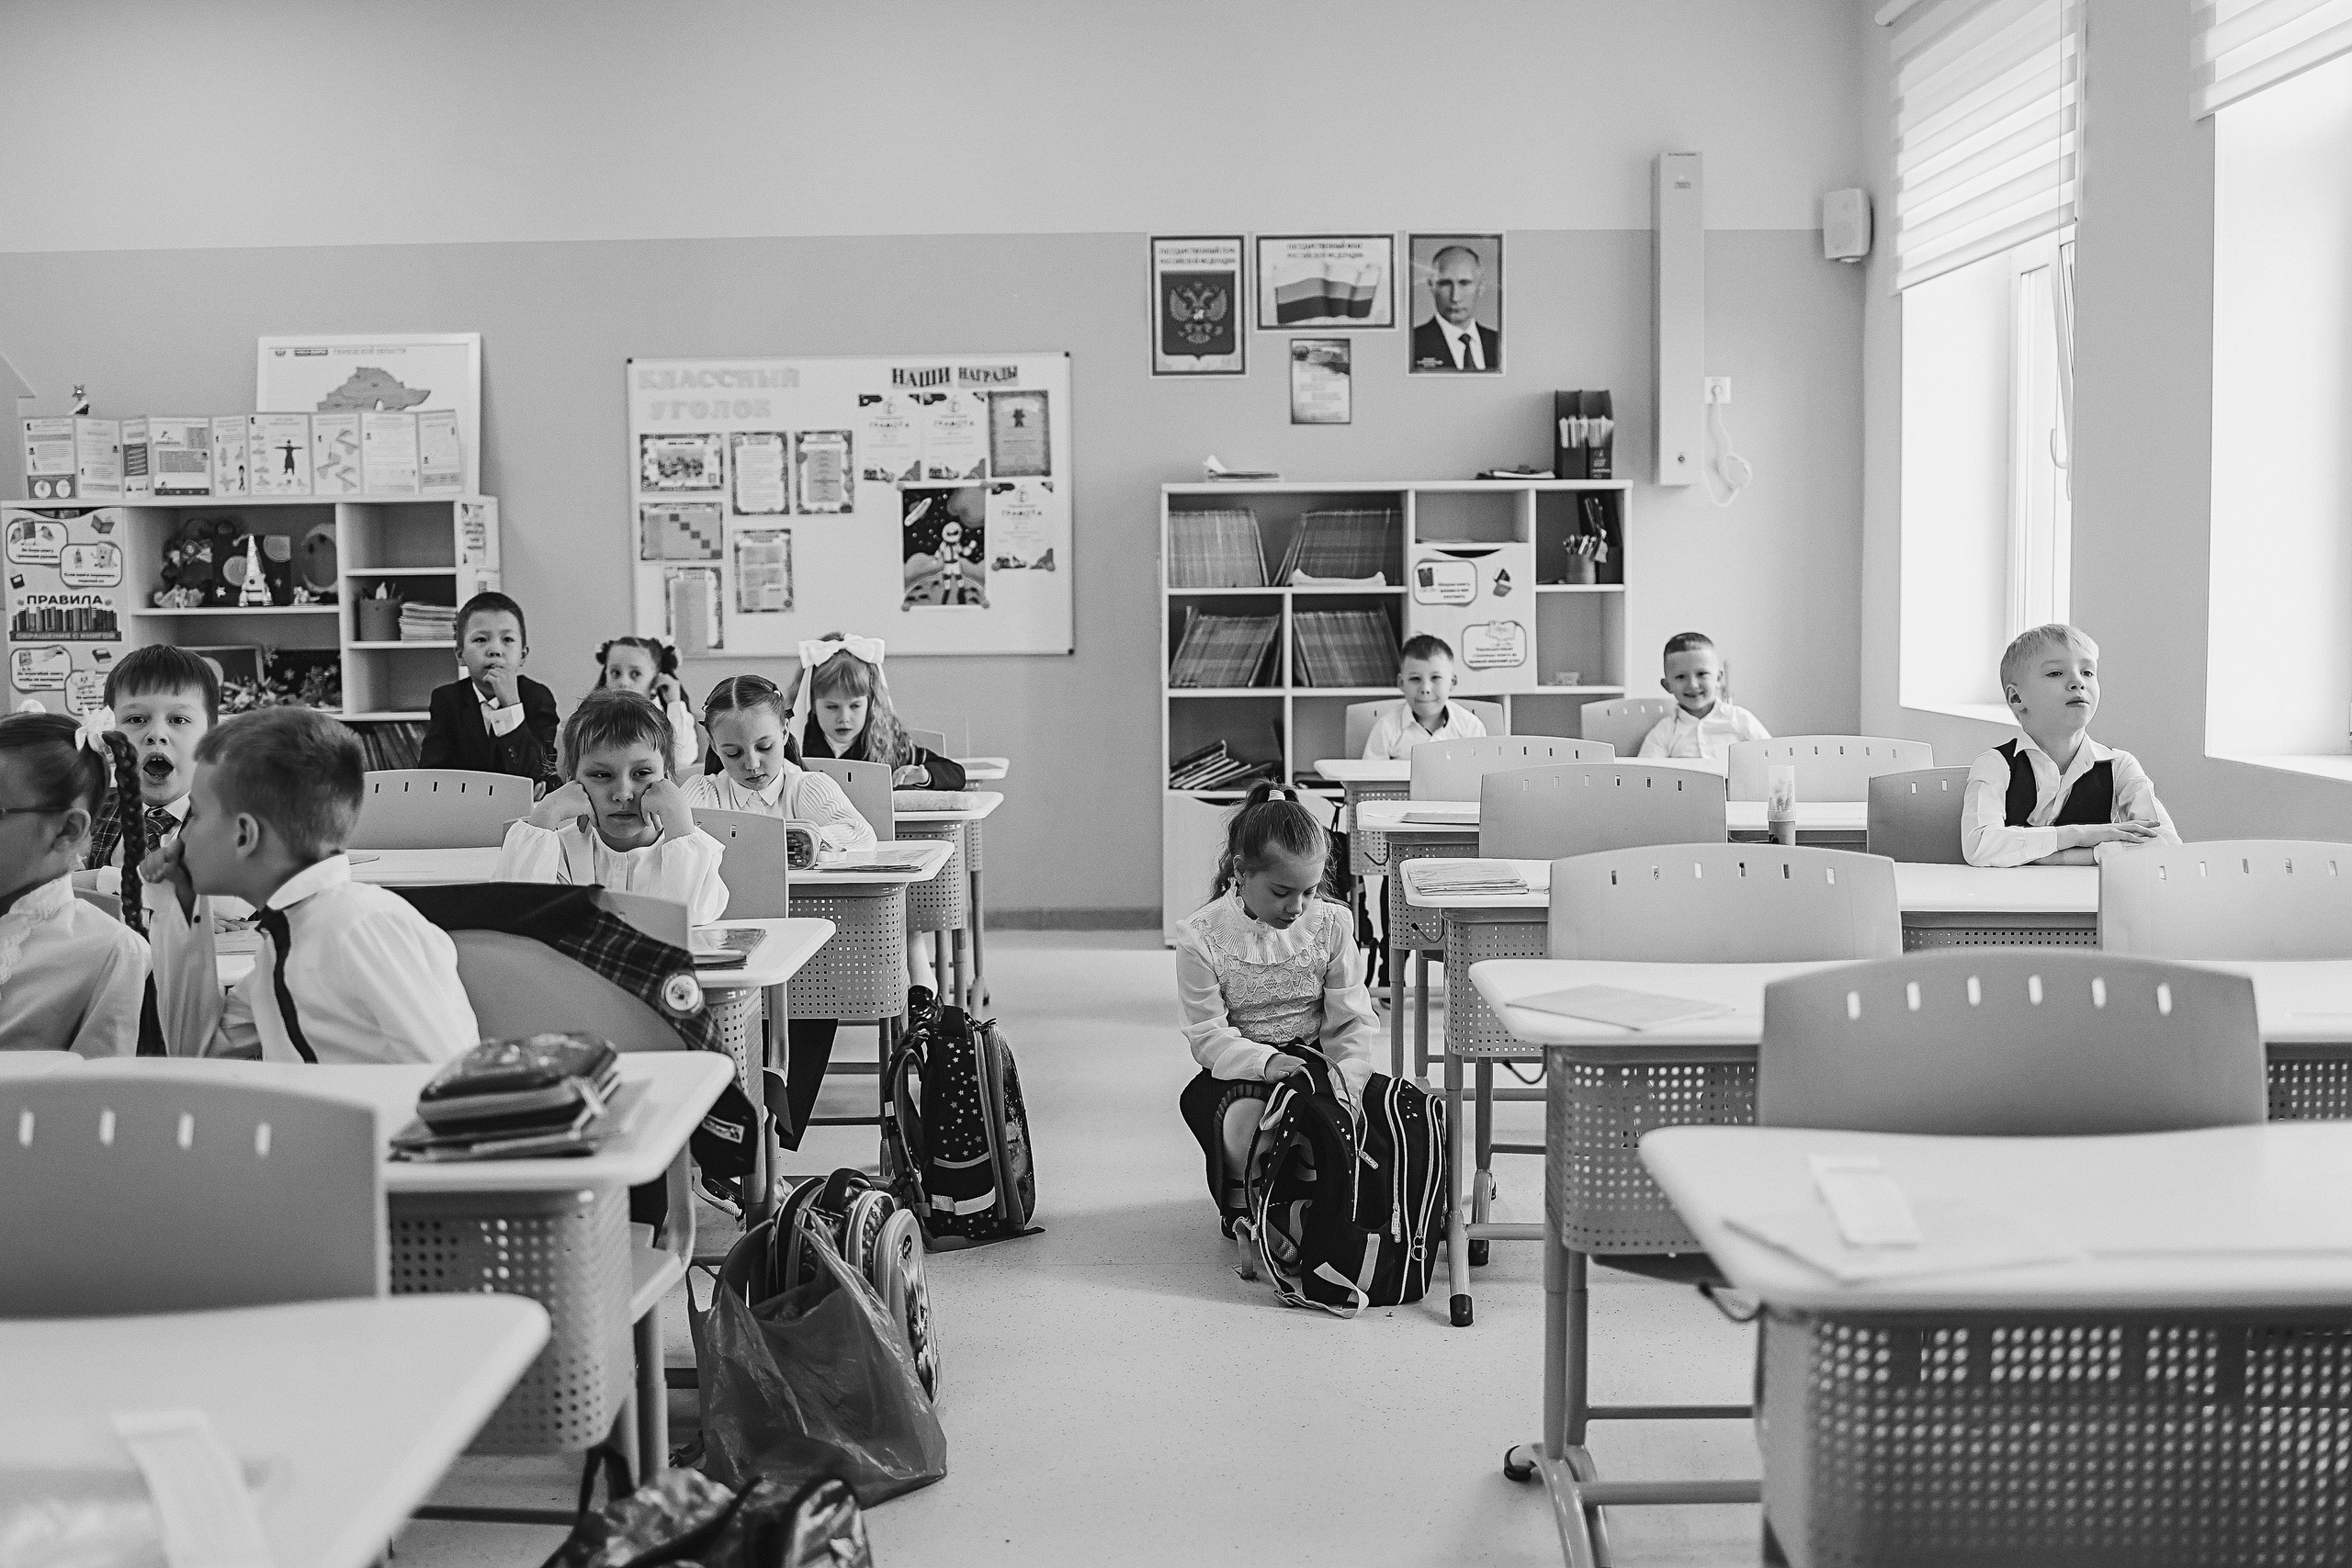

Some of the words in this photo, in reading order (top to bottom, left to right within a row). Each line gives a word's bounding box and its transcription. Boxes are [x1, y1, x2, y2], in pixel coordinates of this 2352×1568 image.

[637, 367, 800, 389] КЛАССНЫЙ
[892, 367, 951, 387] НАШИ
[958, 366, 1018, 382] НАГРАДЫ
[650, 398, 772, 421] УГОЛОК
[27, 595, 103, 605] ПРАВИЛА
